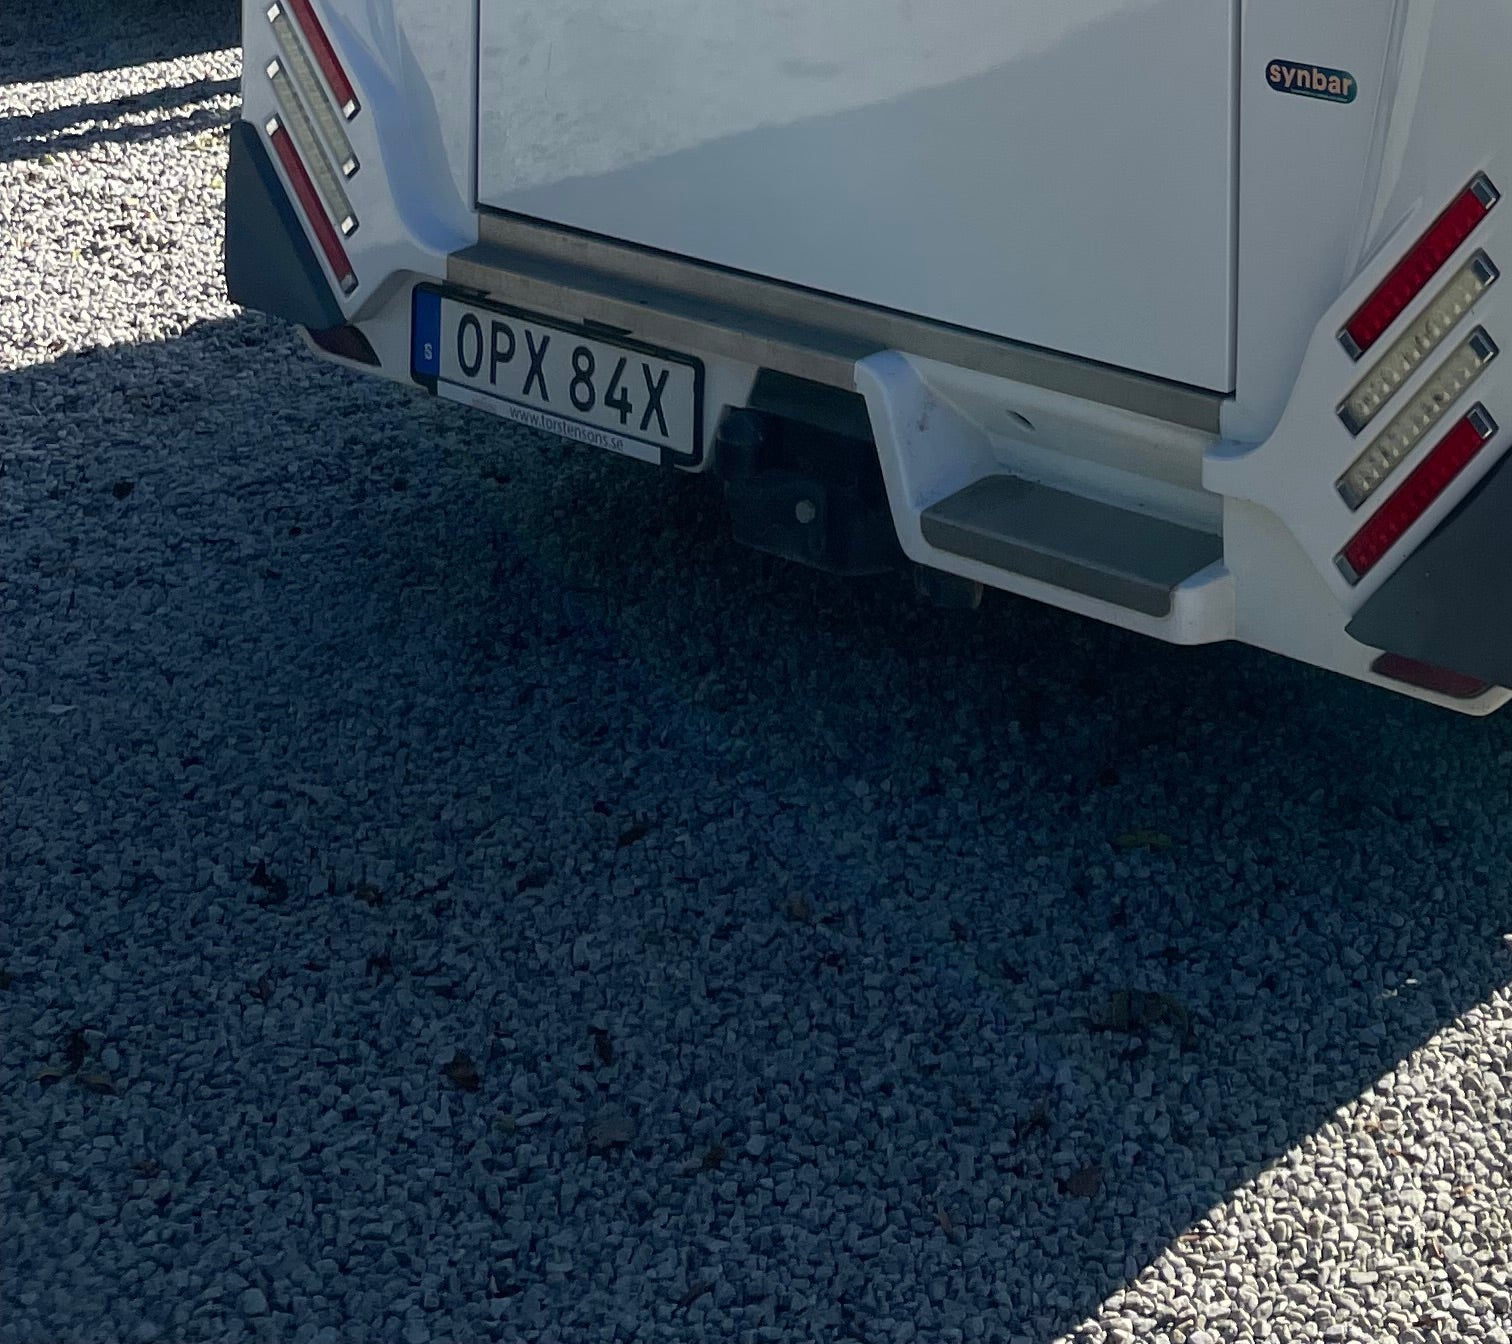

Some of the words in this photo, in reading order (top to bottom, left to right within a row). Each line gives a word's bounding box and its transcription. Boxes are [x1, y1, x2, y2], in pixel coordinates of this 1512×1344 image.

[1270, 64, 1352, 96] synbar
[457, 312, 550, 402] OPX
[569, 345, 670, 438] 84X
[509, 406, 624, 450] www.torstensons.se
